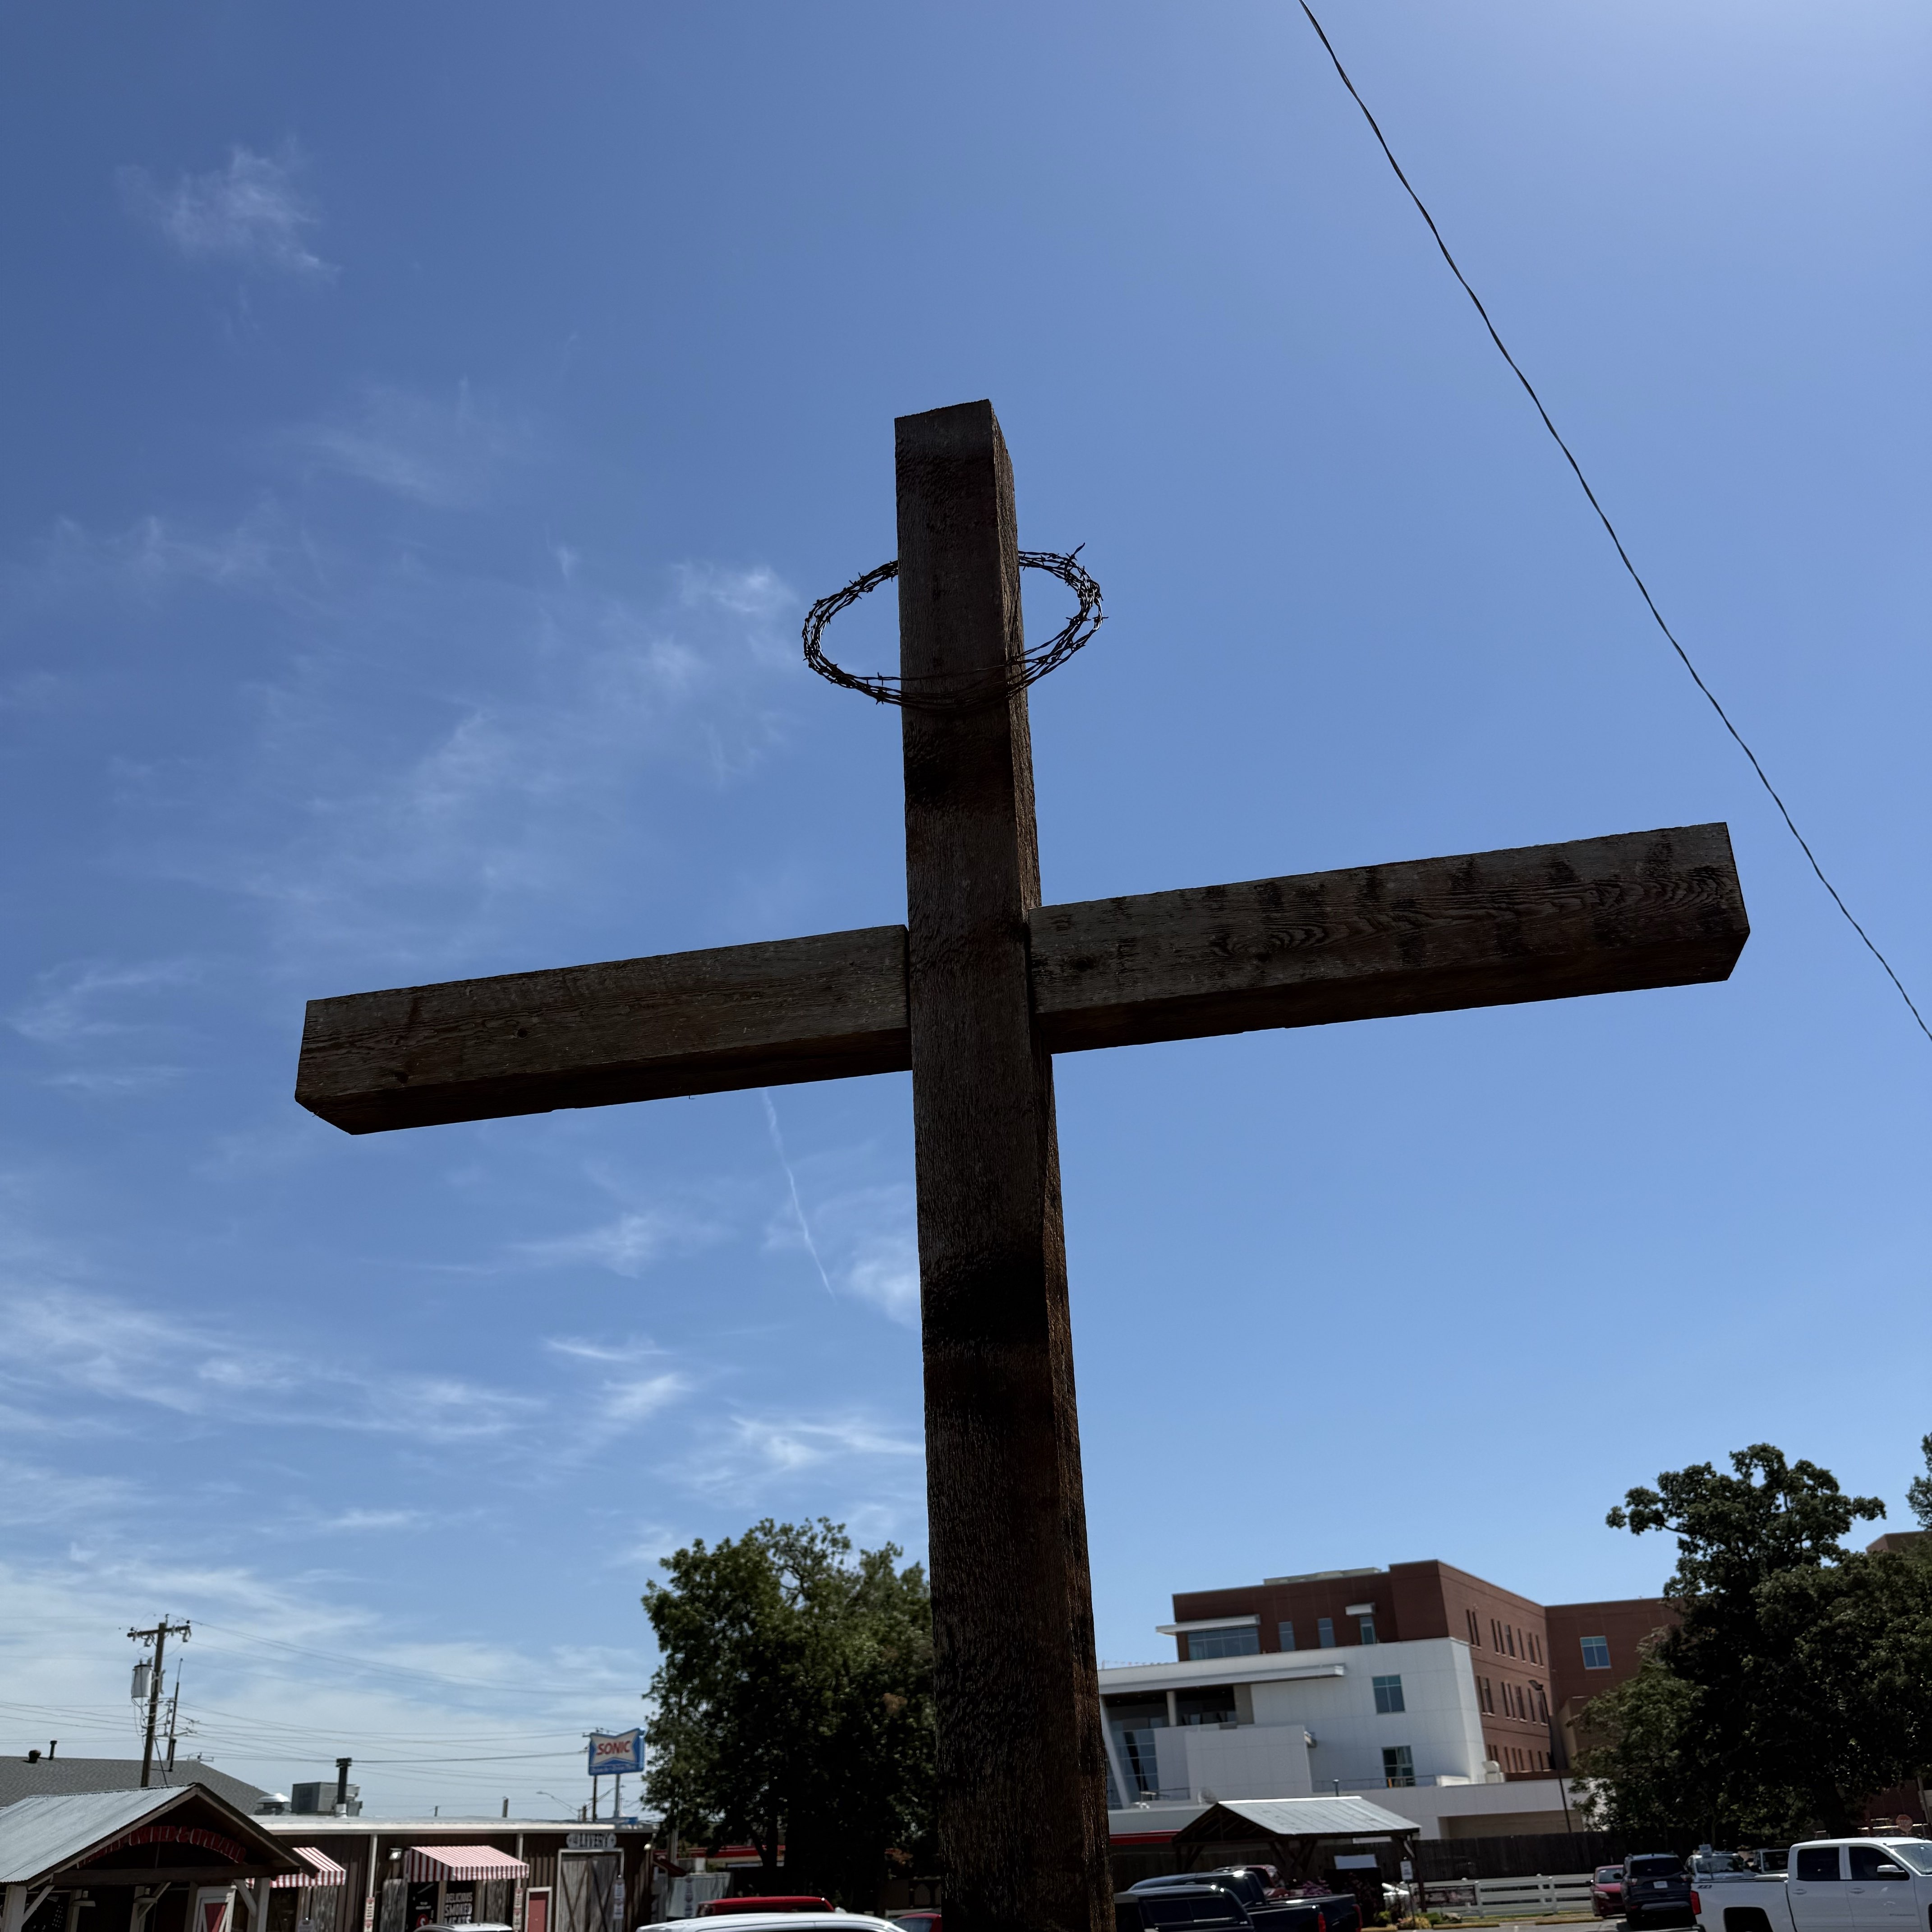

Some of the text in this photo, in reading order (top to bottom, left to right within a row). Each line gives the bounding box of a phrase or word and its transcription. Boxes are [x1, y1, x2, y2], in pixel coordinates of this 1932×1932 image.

[596, 1740, 630, 1755] SONIC
[445, 1892, 473, 1903] DELICIOUS
[444, 1903, 472, 1917] SMOKED
